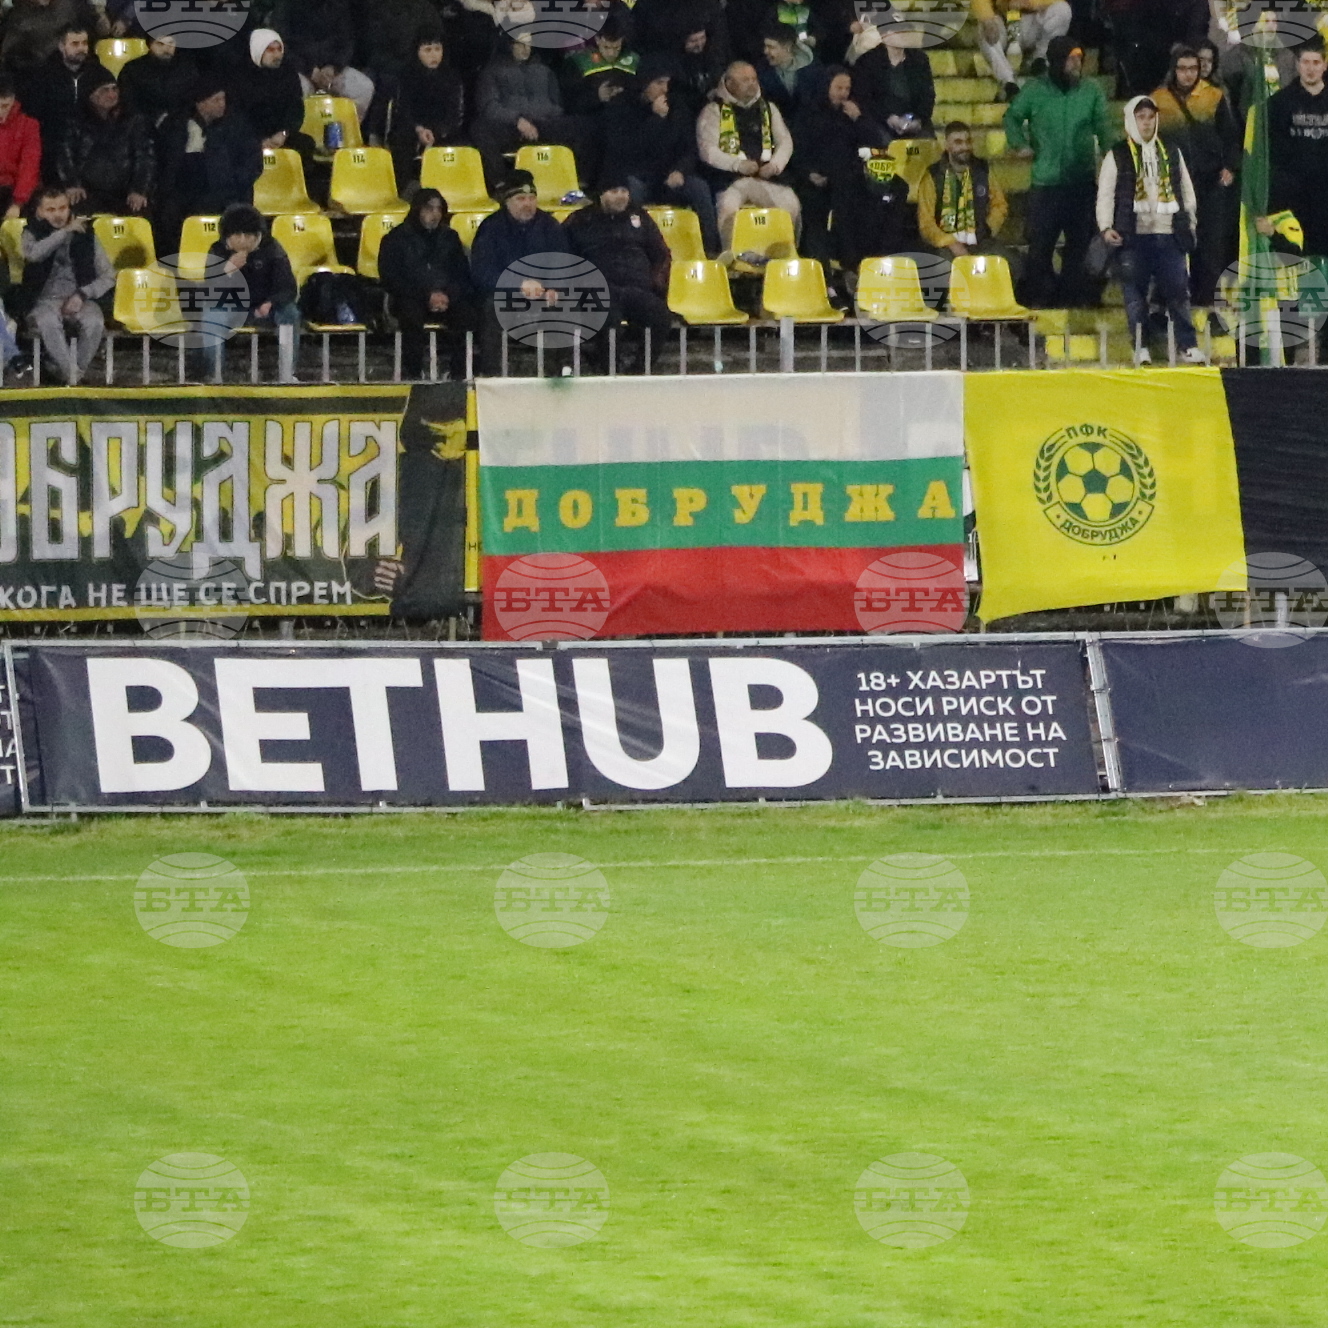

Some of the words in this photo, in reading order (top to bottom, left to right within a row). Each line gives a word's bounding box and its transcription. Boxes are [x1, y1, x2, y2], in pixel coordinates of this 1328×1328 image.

[1065, 423, 1109, 440] ПФК
[503, 480, 957, 532] ДОБРУДЖА
[1060, 516, 1141, 542] ДОБРУДЖА
[87, 584, 128, 609] НЕ
[199, 581, 241, 607] СЕ
[250, 580, 353, 606] СПРЕМ
[857, 671, 901, 691] 18+
[907, 669, 1046, 690] ХАЗАРТЪТ
[855, 696, 935, 718] НОСИ
[943, 696, 1013, 716] РИСК
[1021, 695, 1058, 715] ОТ
[87, 657, 833, 794] BETHUB
[855, 723, 1019, 744] РАЗВИВАНЕ
[1027, 721, 1067, 741] НА
[869, 748, 1060, 771] ЗАВИСИМОСТ
